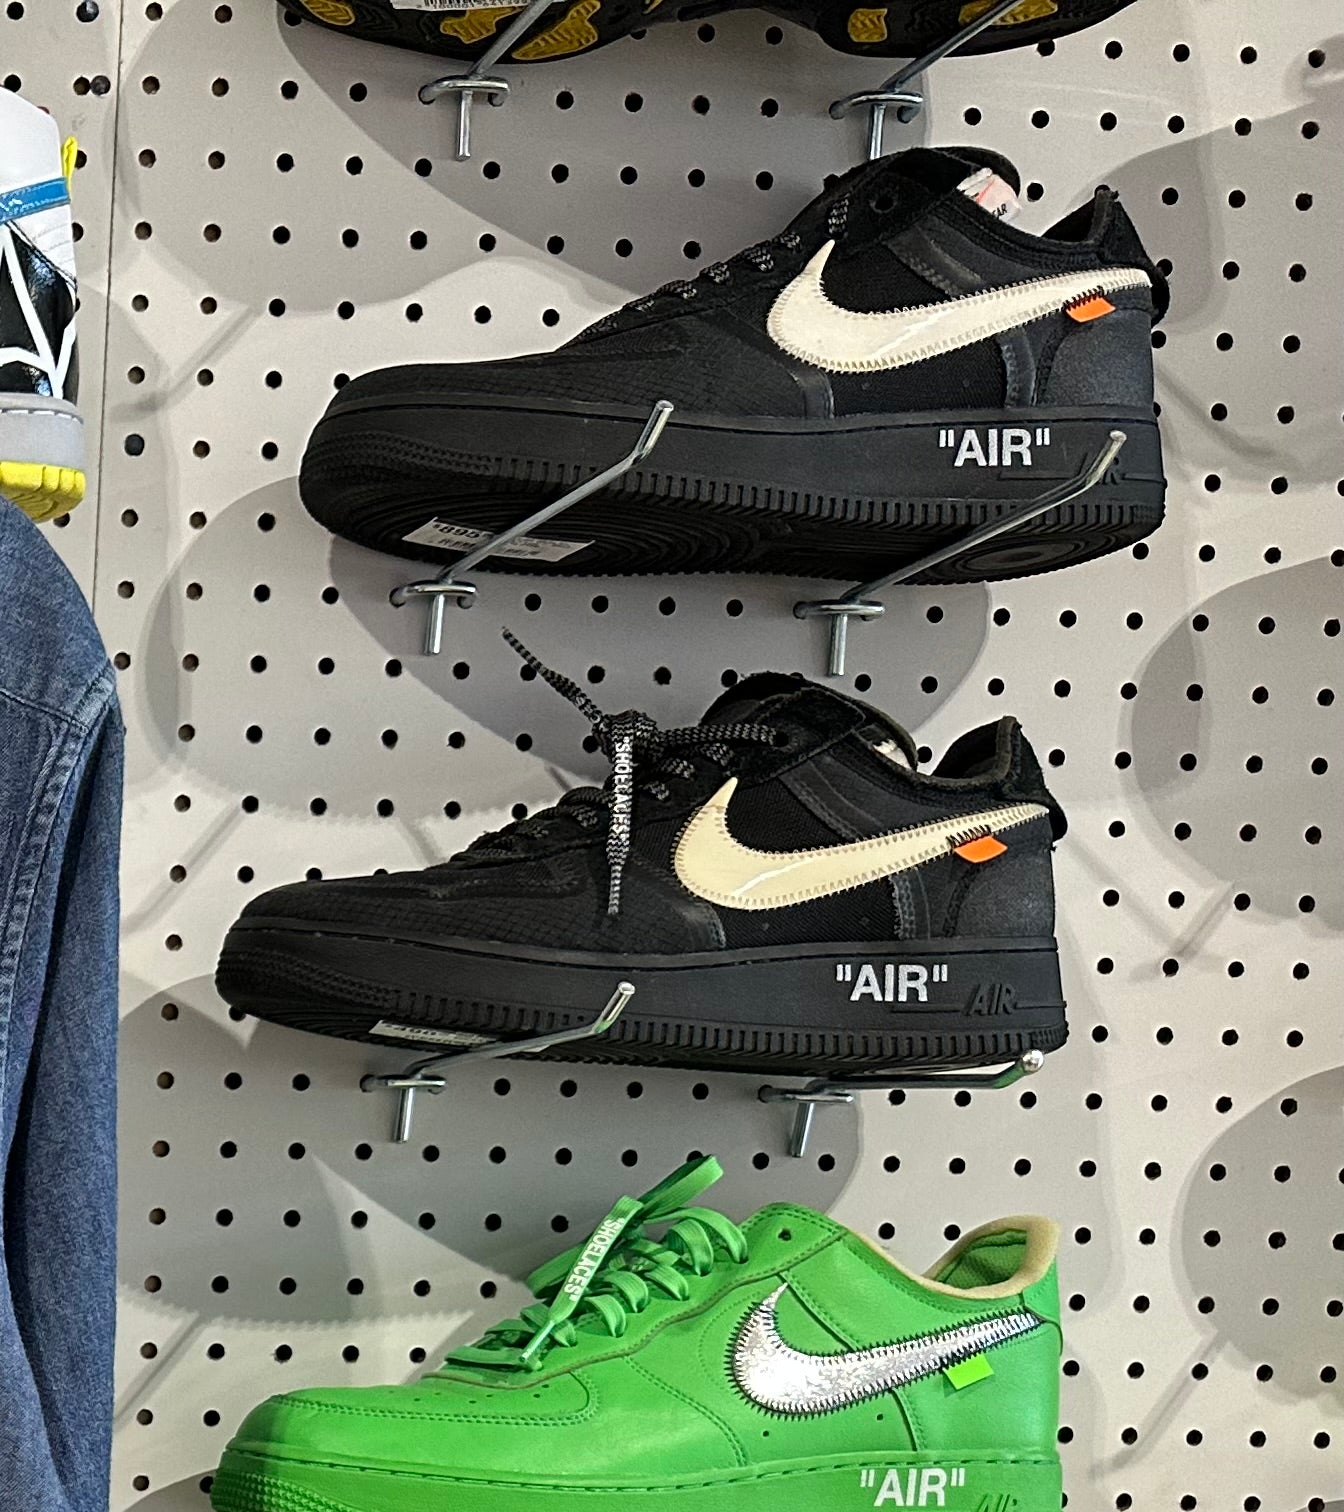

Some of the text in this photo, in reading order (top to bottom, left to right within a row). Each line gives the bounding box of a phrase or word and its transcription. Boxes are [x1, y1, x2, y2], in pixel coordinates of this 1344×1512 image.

[938, 427, 1051, 467] "AIR"
[835, 964, 949, 1002] "AIR"
[964, 983, 1018, 1017] AIR
[564, 1217, 625, 1302] "SHOELACES"
[859, 1467, 966, 1507] "AIR"
